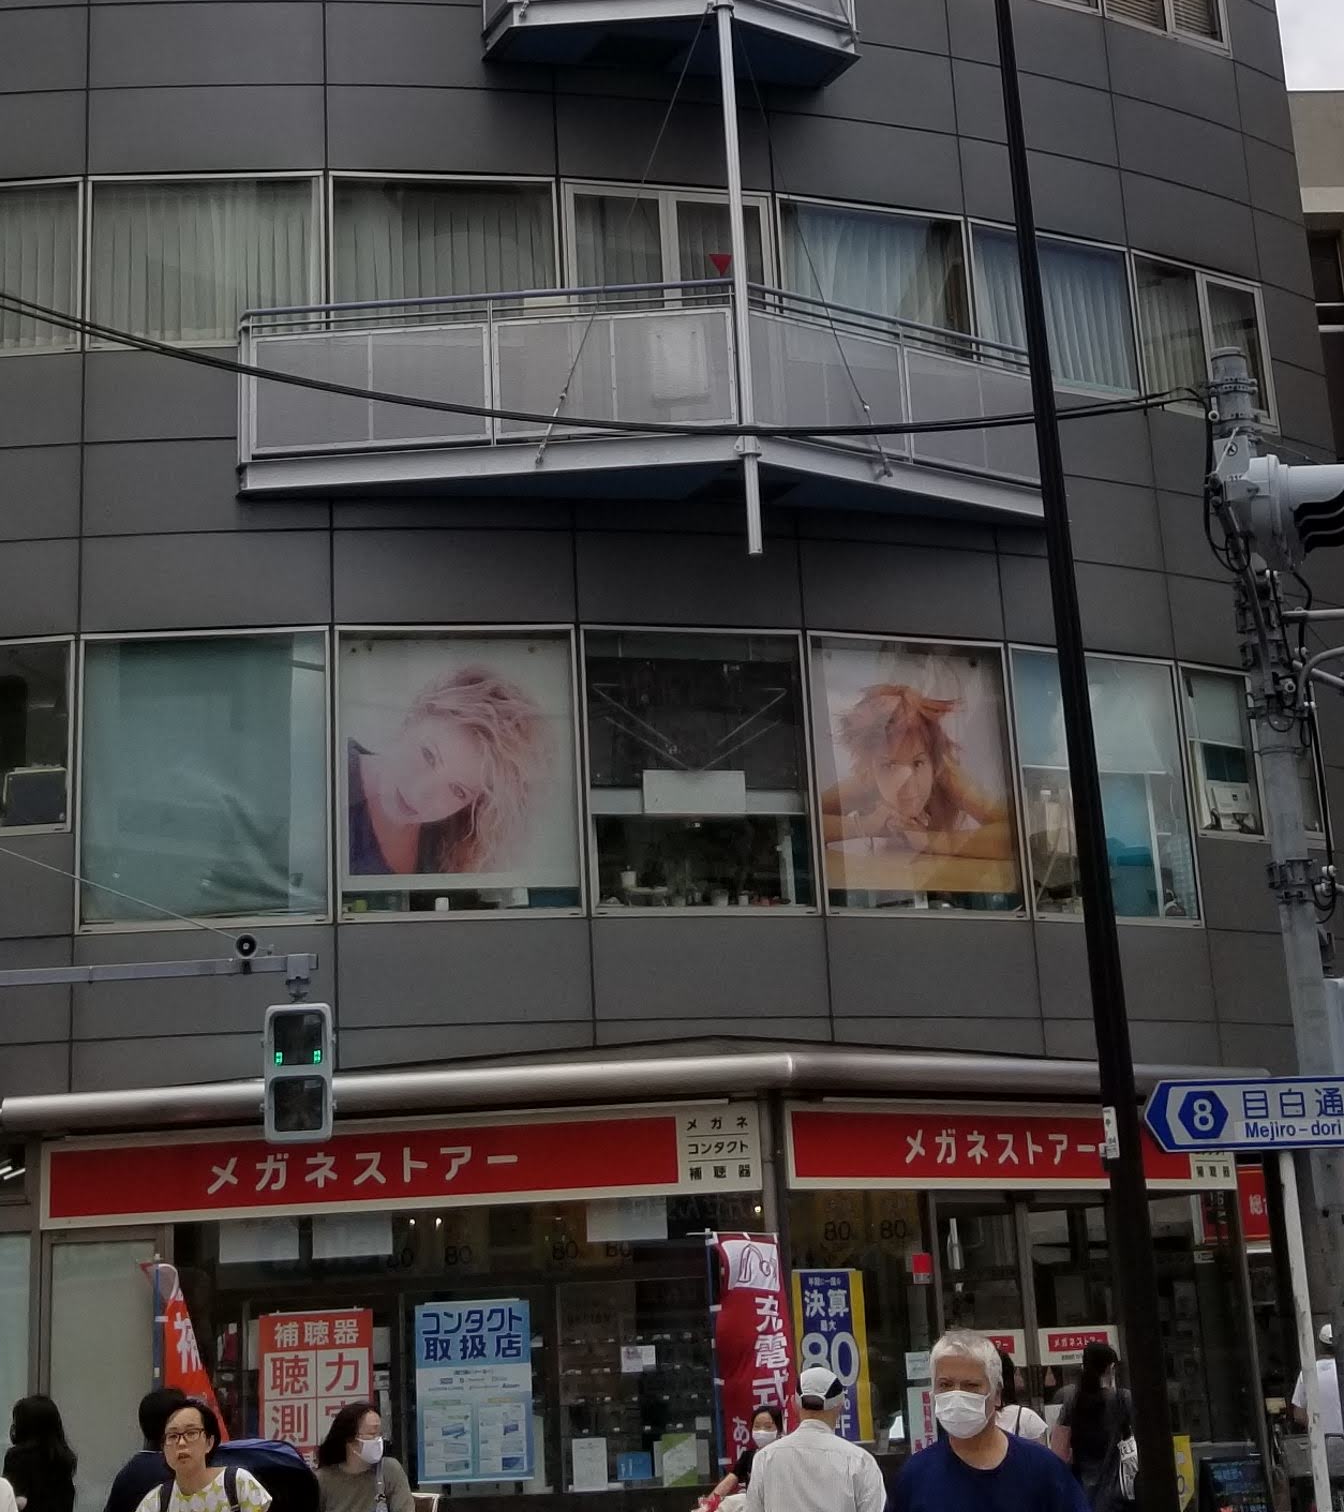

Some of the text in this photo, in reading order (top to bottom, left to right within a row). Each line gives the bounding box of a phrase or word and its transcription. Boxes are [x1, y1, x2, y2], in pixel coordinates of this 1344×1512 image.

[686, 1115, 748, 1131] メガネ
[1193, 1099, 1215, 1132] 8
[1245, 1118, 1342, 1141] Mejiro-dori
[687, 1140, 749, 1155] コンタクト
[904, 1129, 1097, 1166] メガネストアー
[206, 1146, 519, 1195] メガネストアー
[689, 1164, 751, 1181] 補聴器
[804, 1288, 850, 1318] 決算
[274, 1318, 360, 1349] 補聴器
[422, 1307, 523, 1336] コンタクト
[423, 1333, 523, 1362] 取扱店
[801, 1331, 861, 1388] 80
[270, 1352, 360, 1397] 聴力
